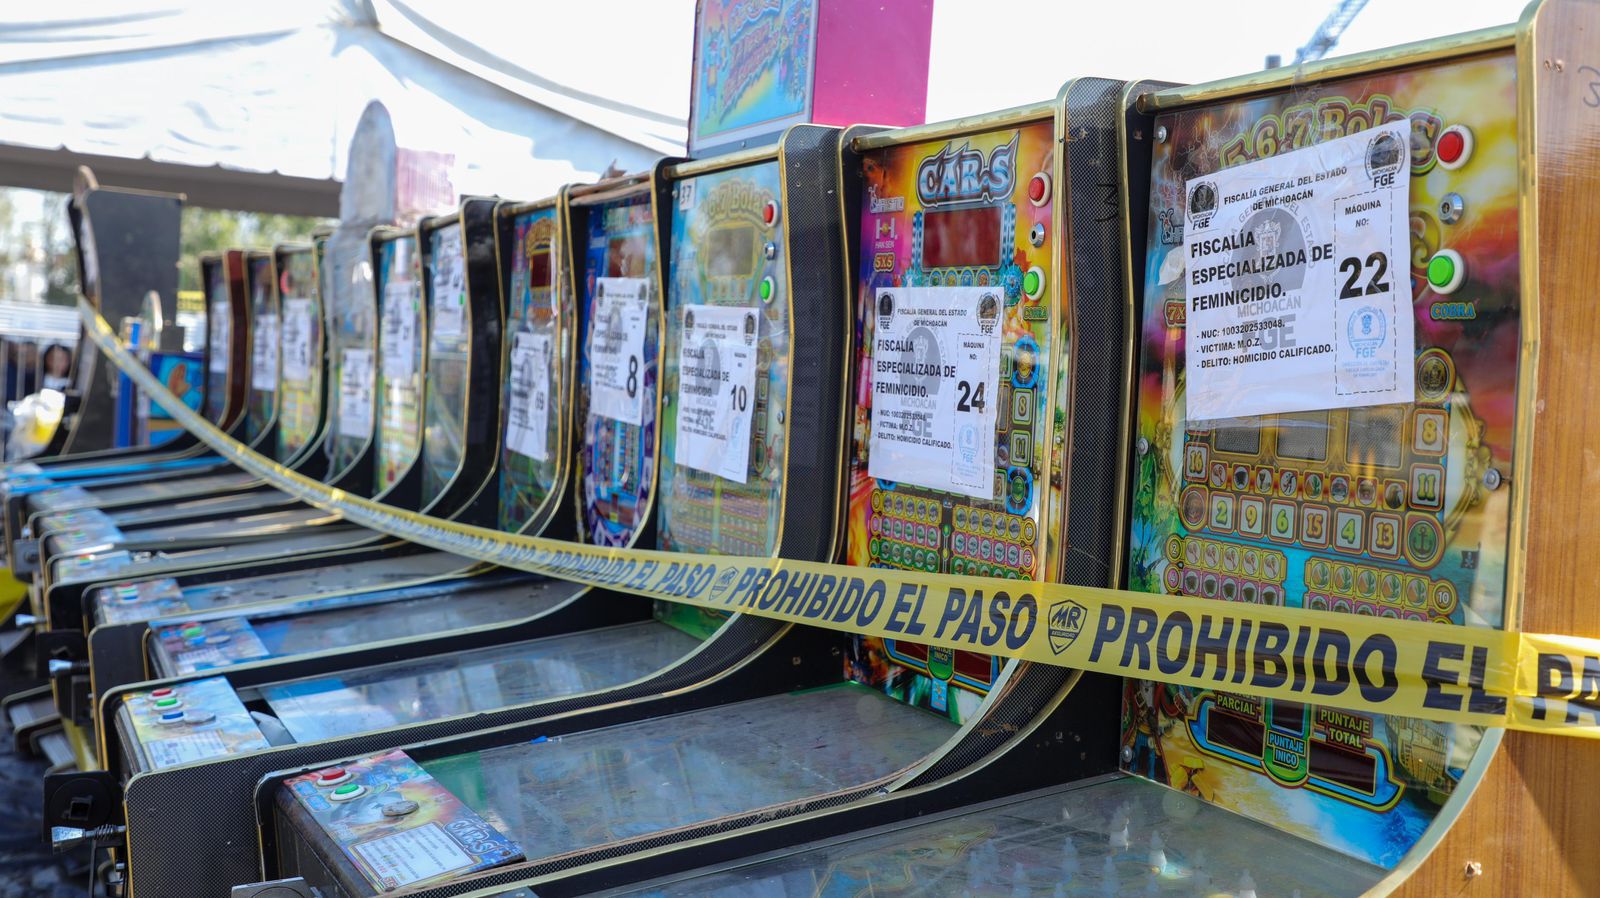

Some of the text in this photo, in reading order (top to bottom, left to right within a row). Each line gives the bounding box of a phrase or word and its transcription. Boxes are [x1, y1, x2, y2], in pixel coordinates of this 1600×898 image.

[918, 143, 1017, 205] CARS
[1224, 166, 1348, 205] FISCALÍA GENERAL DEL ESTADO
[1373, 171, 1396, 188] FGE
[1252, 189, 1314, 212] DE MICHOACÁN
[1193, 217, 1211, 231] FGE
[1190, 229, 1256, 259] FISCALÍA
[1191, 248, 1307, 286] ESPECIALIZADA
[1312, 243, 1333, 262] DE
[1338, 251, 1390, 300] 22
[1192, 282, 1286, 312] FEMINICIDIO.
[1237, 295, 1302, 319] MICHOACÁN
[1431, 302, 1476, 320] COBRA
[980, 324, 995, 334] FGE
[1201, 329, 1220, 340] NUC:
[1242, 313, 1297, 353] FGE
[877, 337, 915, 353] FISCALÍA
[1200, 337, 1263, 354] VICTIMA: M.O.Z.
[1201, 343, 1334, 369] DELITO: HOMICIDIO CALIFICADO.
[1355, 347, 1377, 359] FGE
[626, 354, 638, 399] 8
[876, 360, 957, 378] ESPECIALIZADA DE
[730, 384, 747, 412] 10
[876, 381, 929, 398] FEMINICIDIO.
[956, 380, 986, 414] 24
[1422, 417, 1438, 446] 8
[1416, 472, 1436, 501] 11
[1215, 500, 1395, 550] 2 9 6 15 4 13
[1436, 590, 1450, 604] 10
[1051, 605, 1082, 630] MR
[549, 549, 638, 586] PROHIBIDO
[631, 559, 661, 592] EL
[653, 561, 717, 600] PASO
[725, 566, 887, 628] PROHIBIDO
[883, 582, 929, 637] EL
[933, 586, 1038, 651] PASO
[1087, 602, 1399, 704] PROHIBIDO
[1421, 640, 1508, 716] EL
[1217, 694, 1256, 716] PARCIAL
[1320, 708, 1370, 734] PUNTAJE
[1269, 733, 1304, 754] PUNTAJE
[1328, 726, 1363, 749] TOTAL
